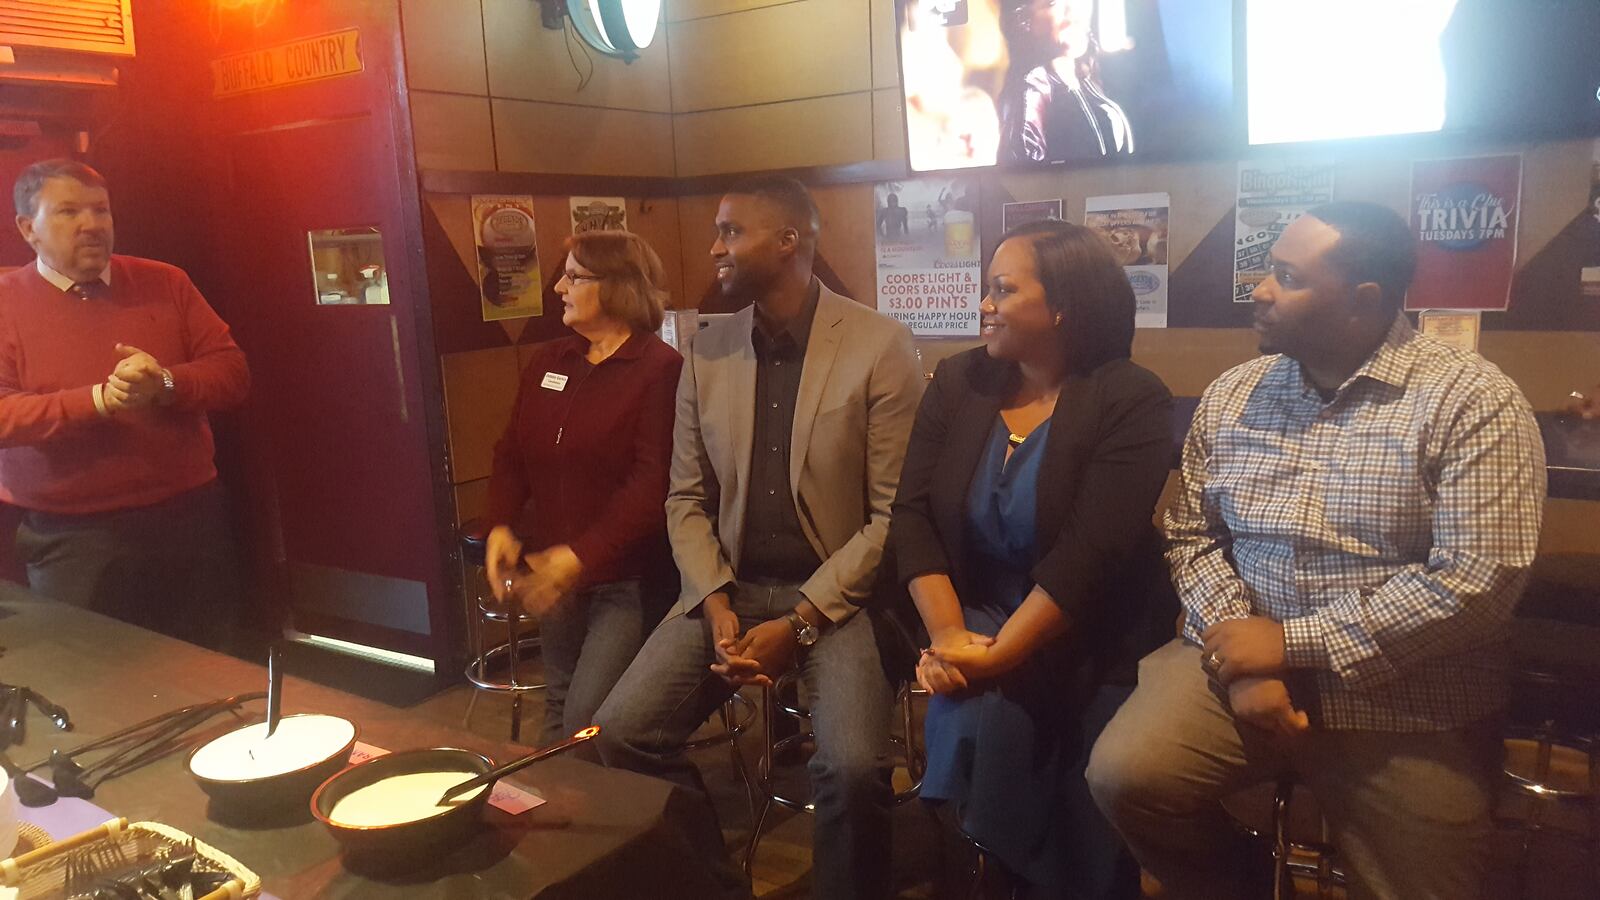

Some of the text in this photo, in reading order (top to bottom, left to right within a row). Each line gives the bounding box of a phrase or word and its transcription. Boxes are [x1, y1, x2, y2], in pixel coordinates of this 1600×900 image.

[222, 36, 347, 91] BUFFALO COUNTRY
[1416, 193, 1440, 209] This
[1418, 207, 1508, 231] TRIVIA
[1420, 228, 1505, 241] TUESDAYS 7PM
[886, 272, 972, 284] COORS LIGHT &
[881, 284, 978, 296] COORS BANQUET
[889, 296, 968, 309] $3.00 PINTS
[917, 312, 947, 320] HAPPY
[949, 312, 977, 320] HOUR
[908, 321, 968, 329] REGULAR PRICE
